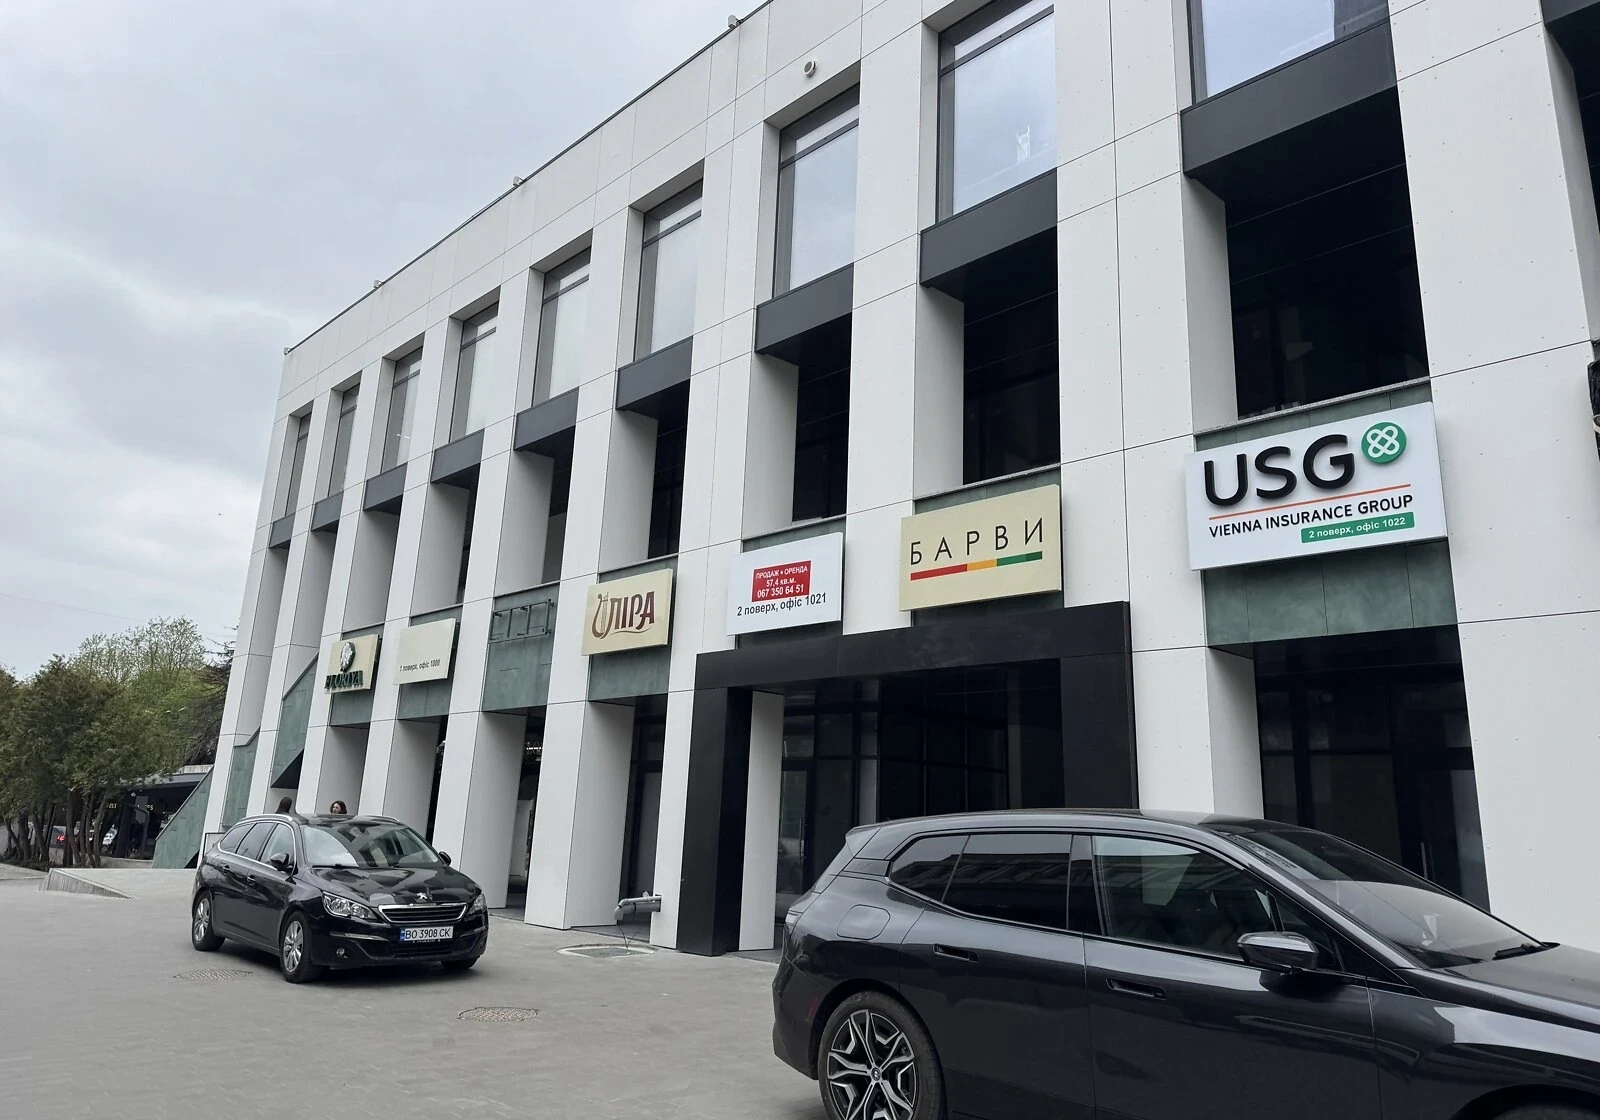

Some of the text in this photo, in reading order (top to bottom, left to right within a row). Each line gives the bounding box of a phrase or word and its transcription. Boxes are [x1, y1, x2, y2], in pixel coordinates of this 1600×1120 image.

[1204, 434, 1356, 507] USG
[1209, 494, 1413, 538] VIENNA INSURANCE GROUP
[1309, 517, 1406, 538] 2 поверх, офіс 1022
[910, 517, 1043, 566] БАРВИ
[756, 565, 808, 580] ПРОДАЖ ОРЕНДА
[757, 584, 804, 598] 067 350 64 51
[737, 592, 827, 616] 2 поверх, офіс 1021
[405, 928, 451, 939] BO 3908 CK
